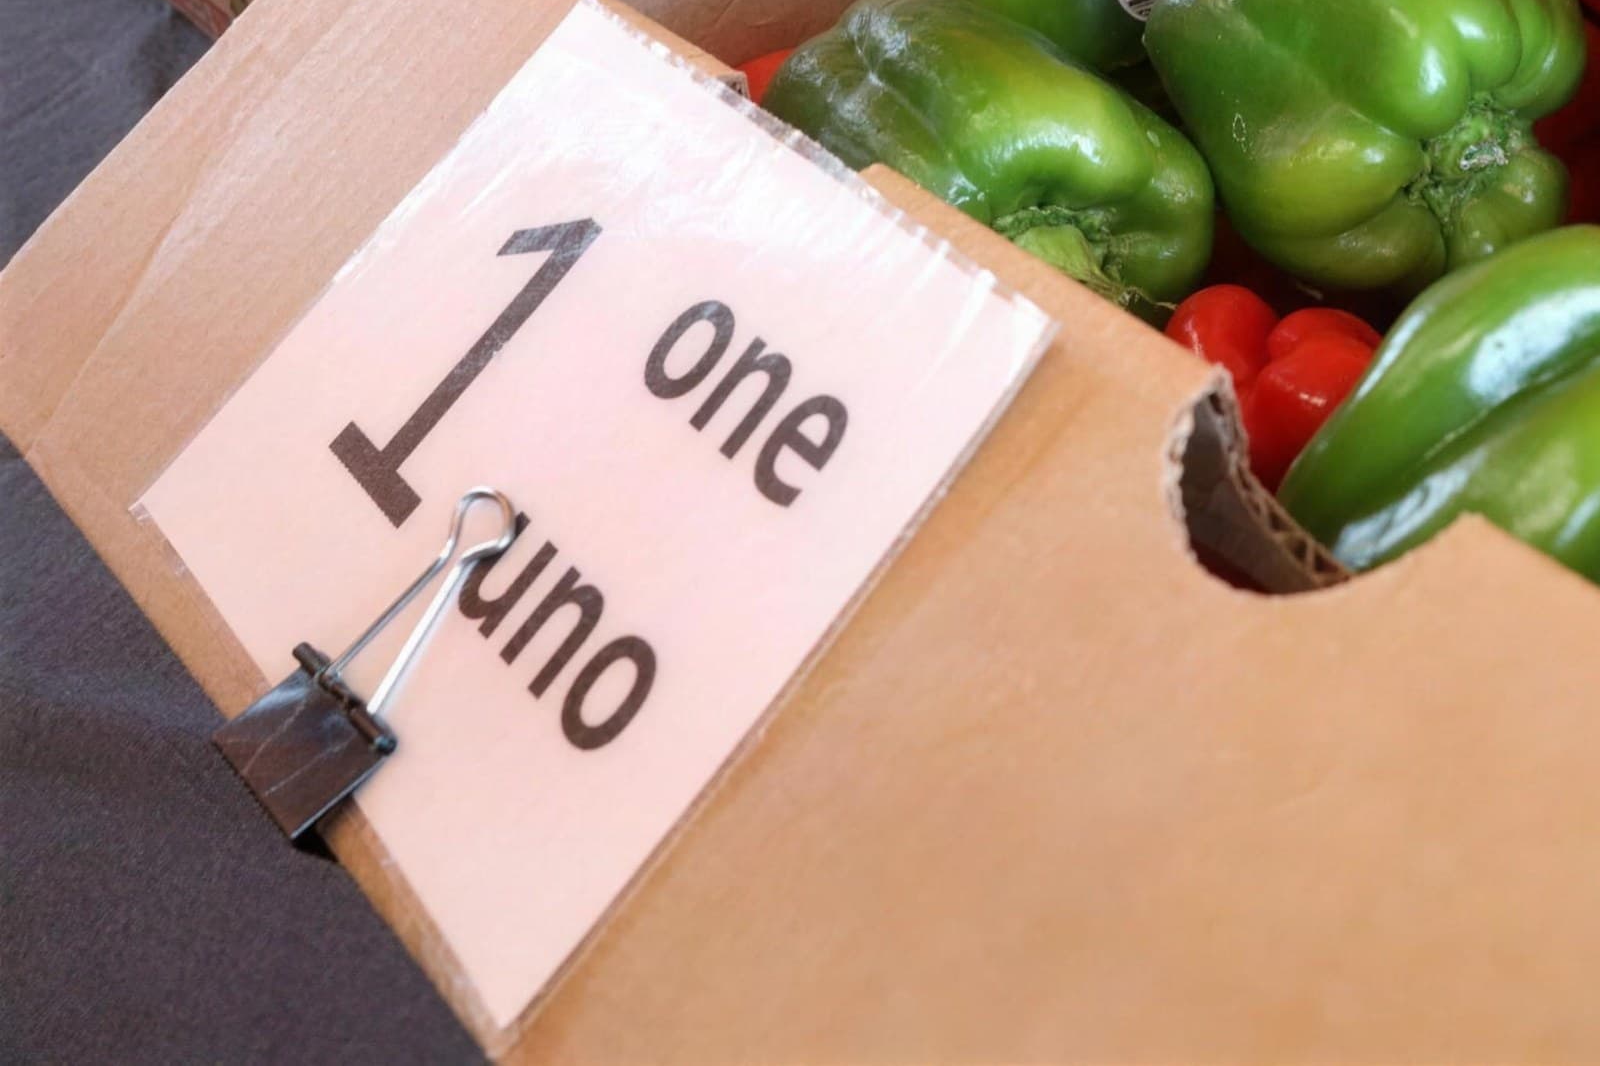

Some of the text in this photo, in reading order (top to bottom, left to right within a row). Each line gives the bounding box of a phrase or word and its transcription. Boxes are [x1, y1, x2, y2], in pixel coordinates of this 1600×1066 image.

[328, 217, 603, 529] 1
[643, 298, 849, 508] one
[457, 510, 657, 752] uno
